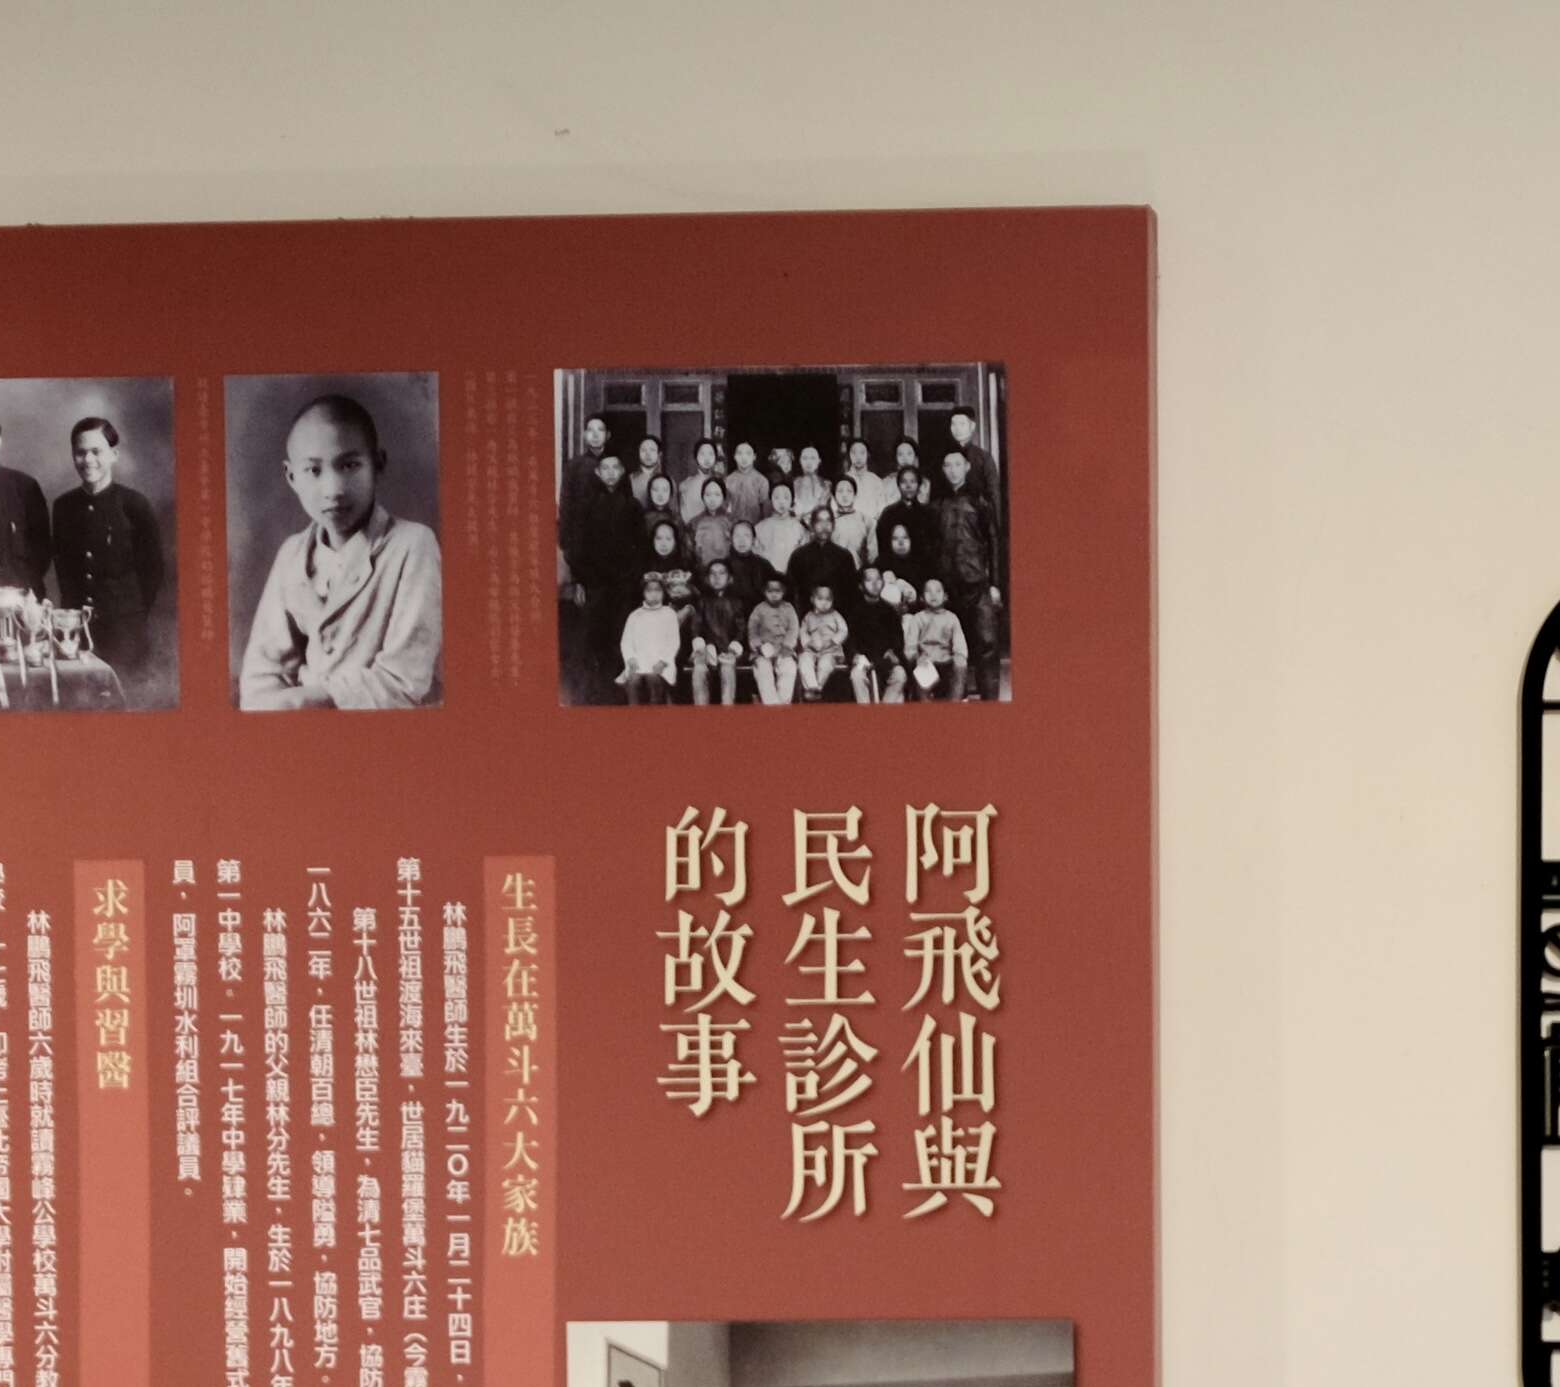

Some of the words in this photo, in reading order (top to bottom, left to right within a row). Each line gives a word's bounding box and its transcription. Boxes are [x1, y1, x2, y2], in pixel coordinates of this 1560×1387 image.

[92, 879, 131, 1090] 求學與習醫
[501, 872, 539, 1256] 生長在萬斗六大家族
[655, 805, 758, 1118] 的故事
[778, 805, 879, 1223] 民生診所
[901, 802, 1002, 1218] 阿飛仙與
